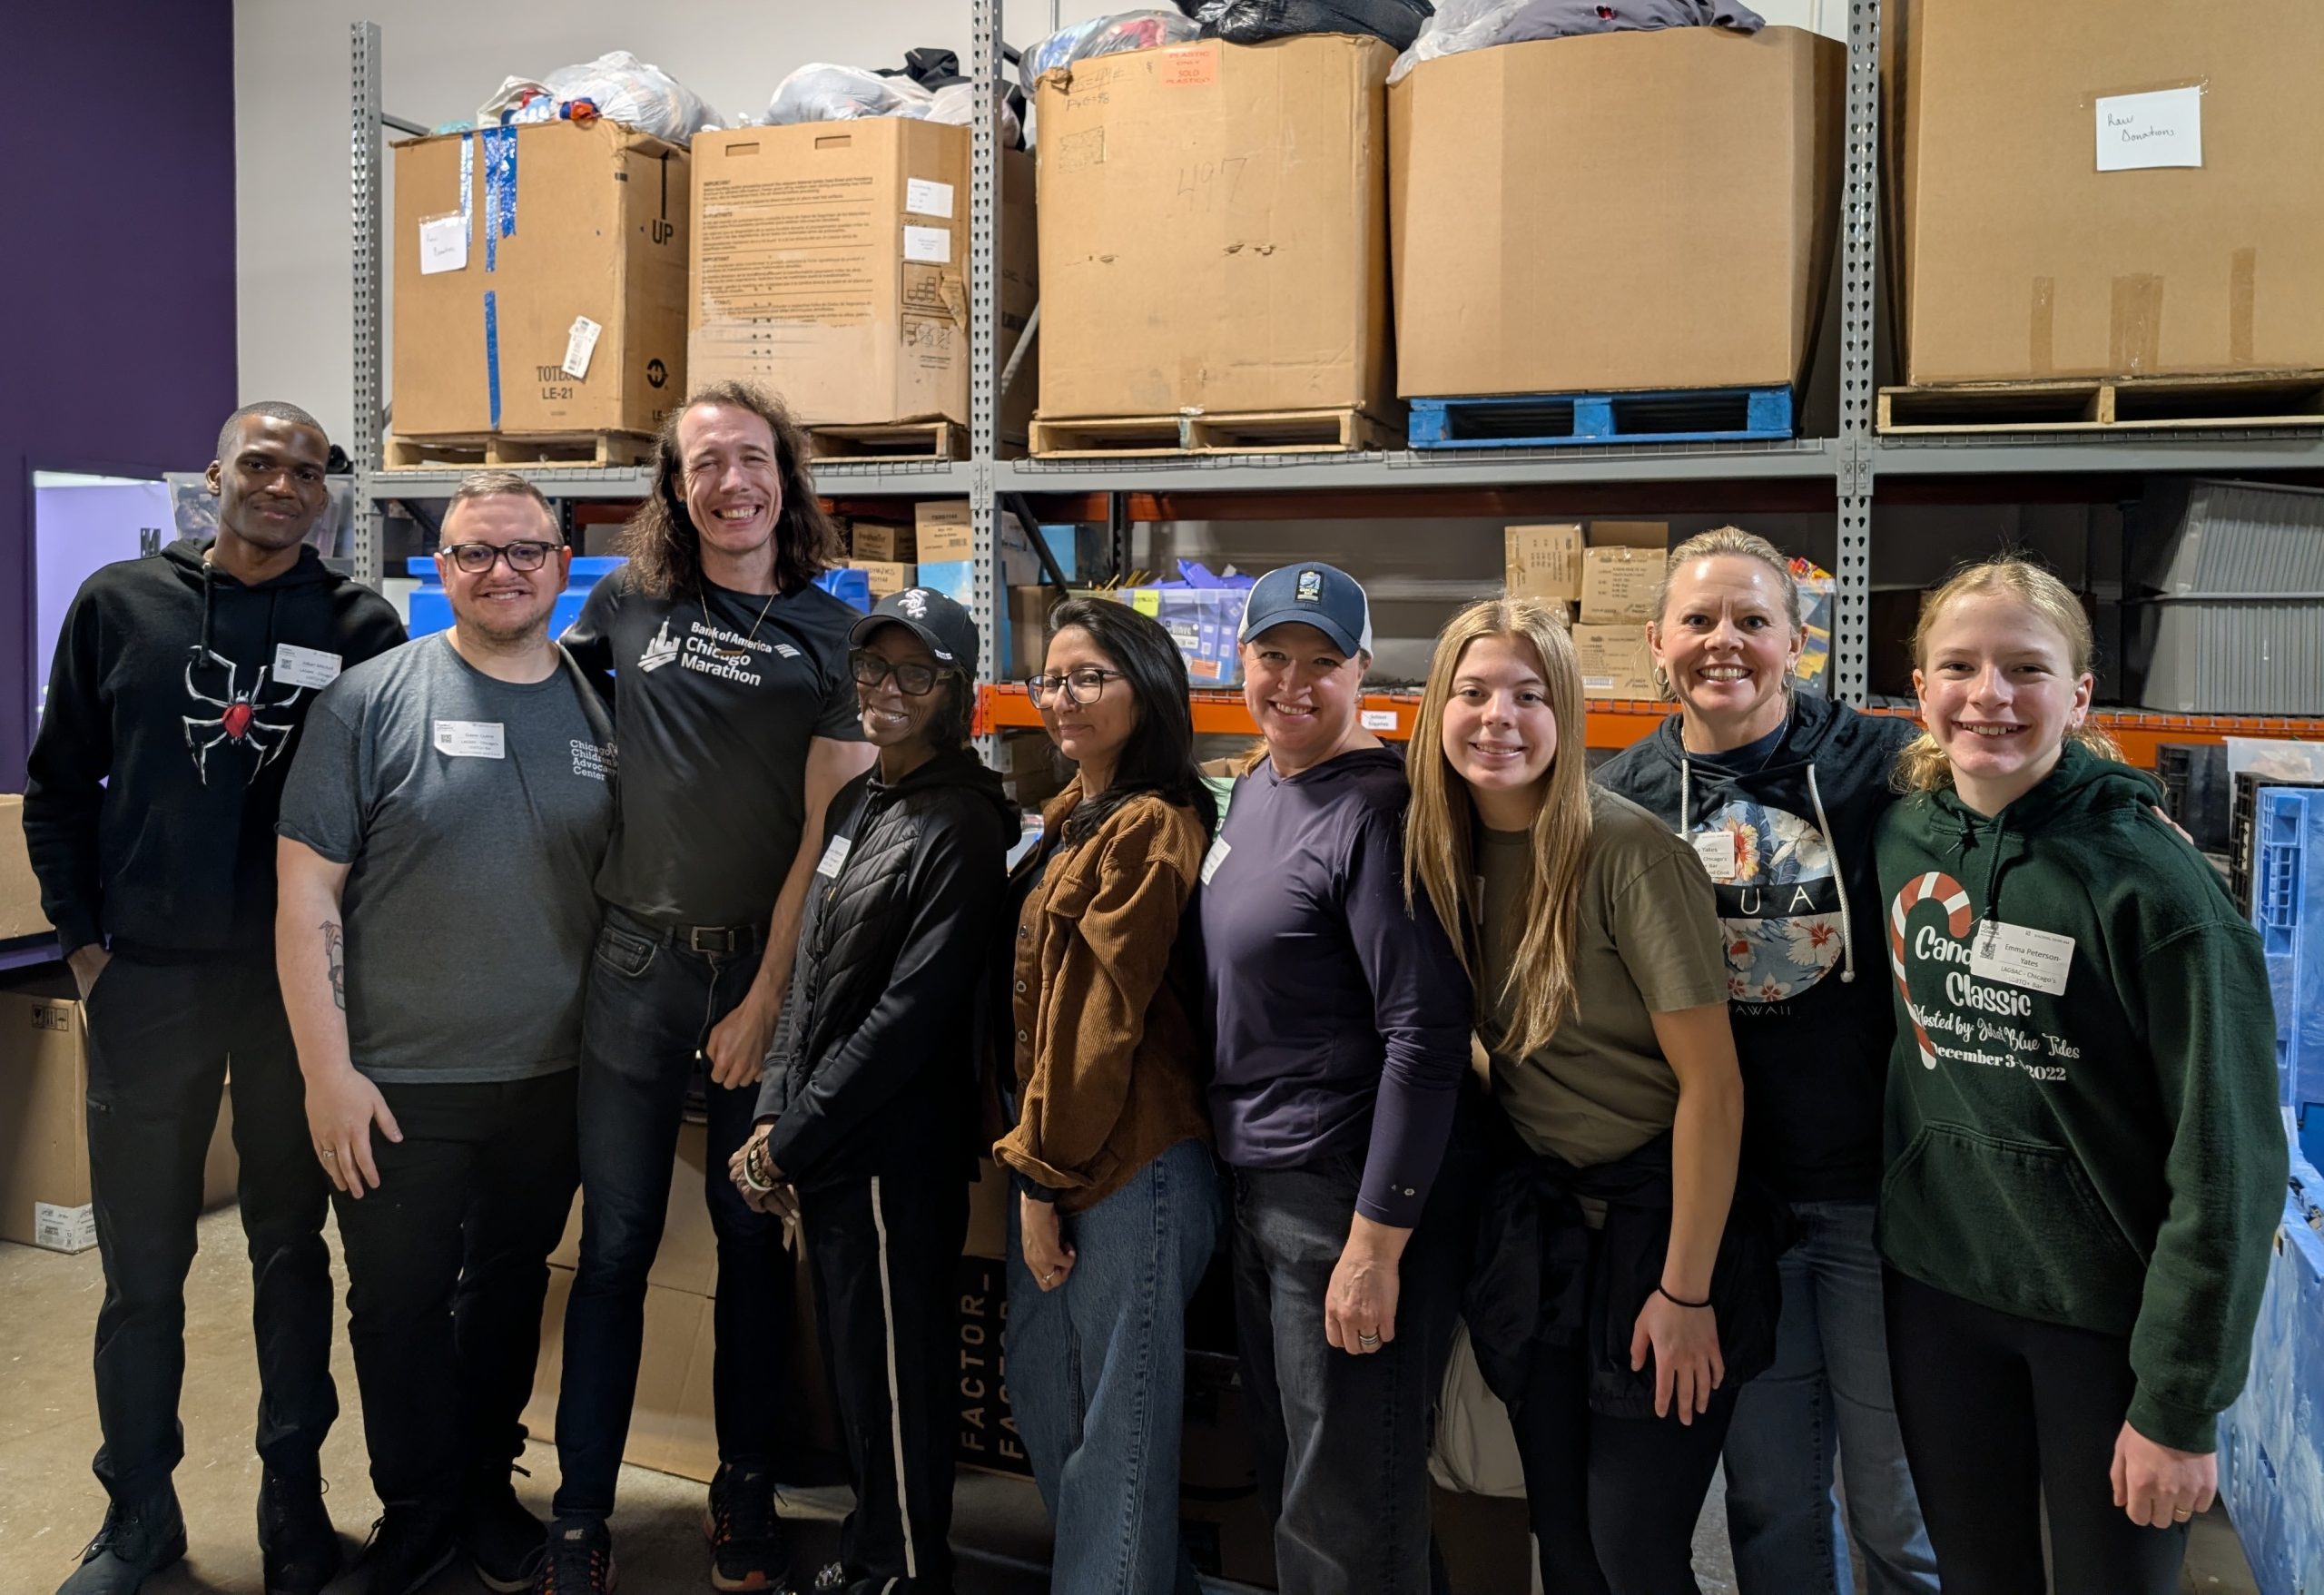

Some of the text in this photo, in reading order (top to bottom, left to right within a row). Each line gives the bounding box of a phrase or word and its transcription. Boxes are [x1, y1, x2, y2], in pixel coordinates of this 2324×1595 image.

[1177, 69, 1200, 77] SOLO
[2122, 124, 2175, 143] Donations
[652, 219, 674, 246] UP
[542, 387, 574, 399] LE-21
[691, 621, 773, 654] Bank of America
[681, 652, 762, 687] Marathon
[569, 739, 611, 757] Chicago
[573, 767, 606, 782] Center
[1915, 925, 1973, 966] Can
[2004, 943, 2062, 962] Emma Peterson-
[2020, 957, 2039, 968] Yates
[2027, 971, 2056, 984] Chicago's
[2032, 981, 2043, 989] Bar
[1945, 971, 2032, 1017] Classic
[1728, 1005, 1791, 1016] AWAII
[1913, 1003, 1954, 1030] Hosted
[2004, 1027, 2041, 1052] Blue
[2042, 1032, 2081, 1059] Tides
